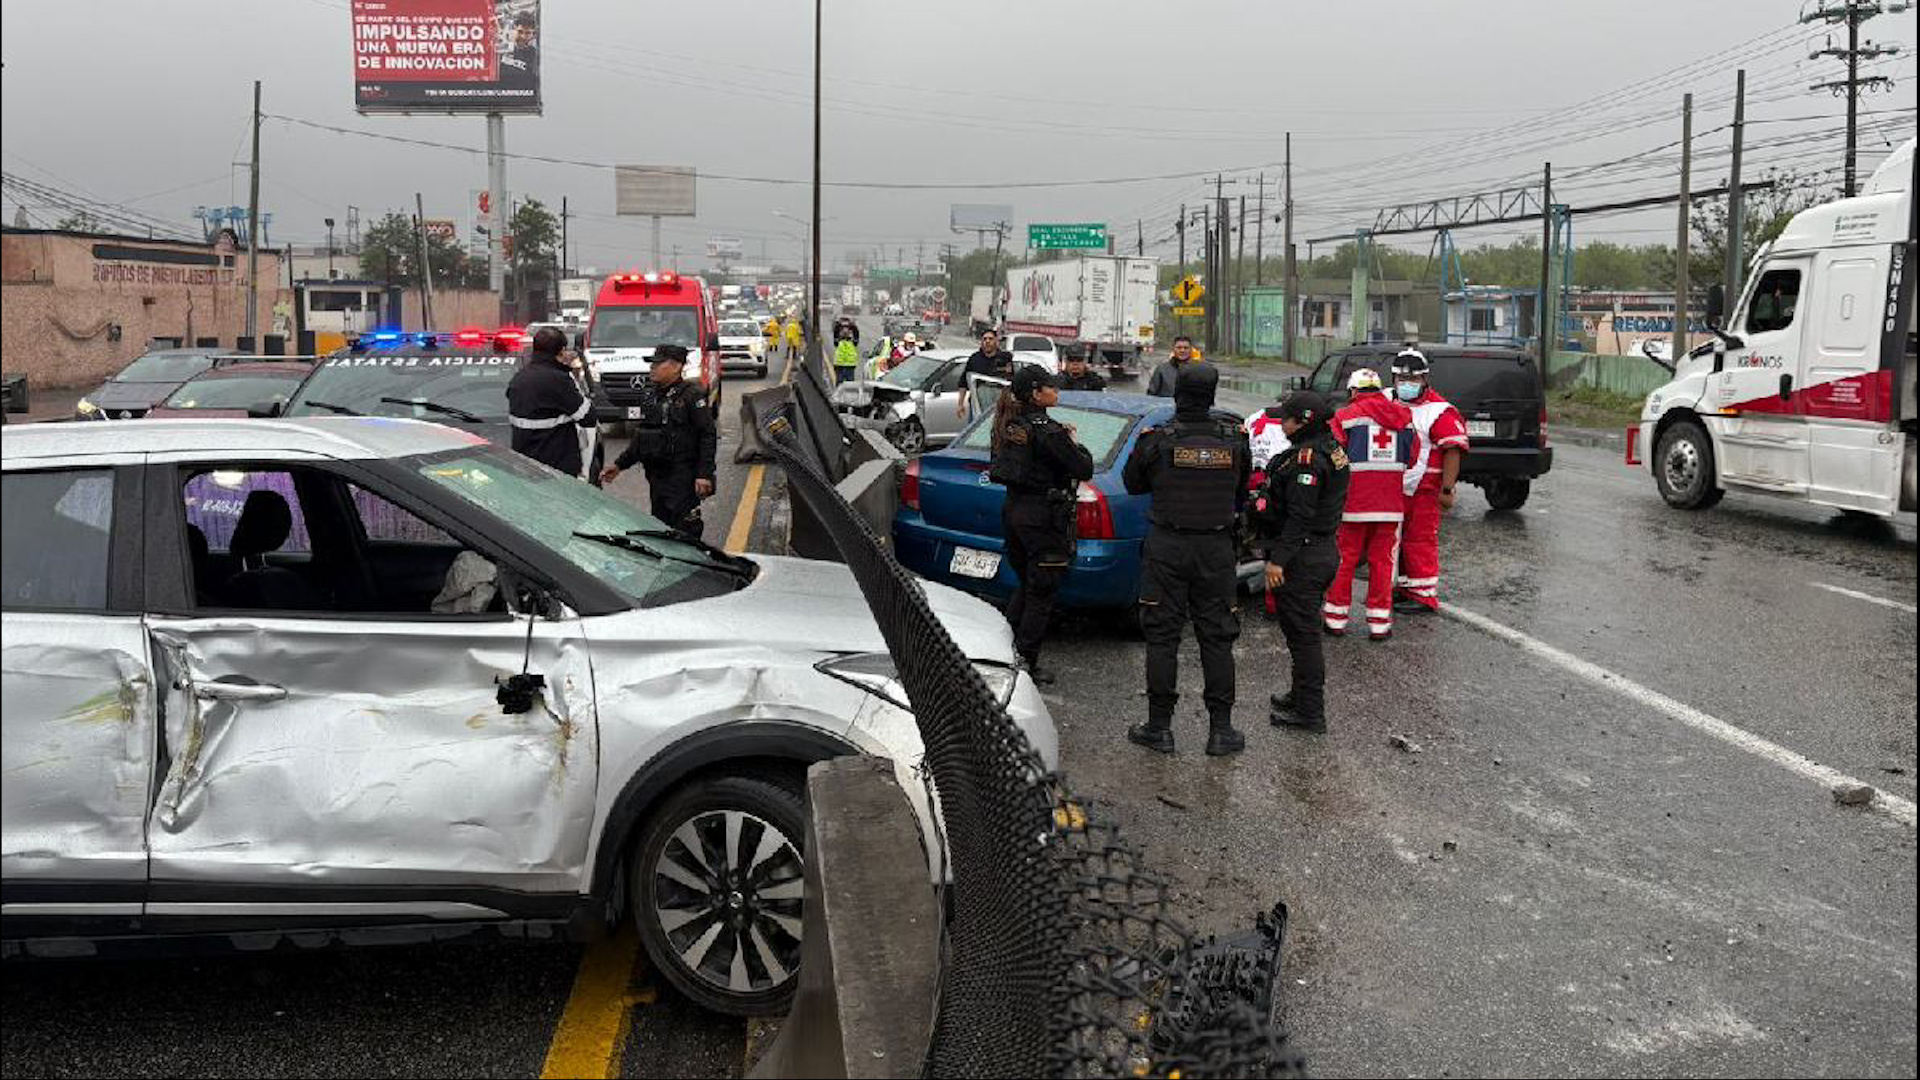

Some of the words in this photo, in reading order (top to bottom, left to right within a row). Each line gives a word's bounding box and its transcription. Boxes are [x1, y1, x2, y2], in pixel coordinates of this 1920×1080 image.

[355, 24, 484, 40] IMPULSANDO
[356, 41, 391, 53] UNA
[396, 42, 447, 54] NUEVA
[452, 42, 485, 54] ERA
[358, 56, 381, 69] DE
[385, 55, 485, 70] INNOVACIÓN
